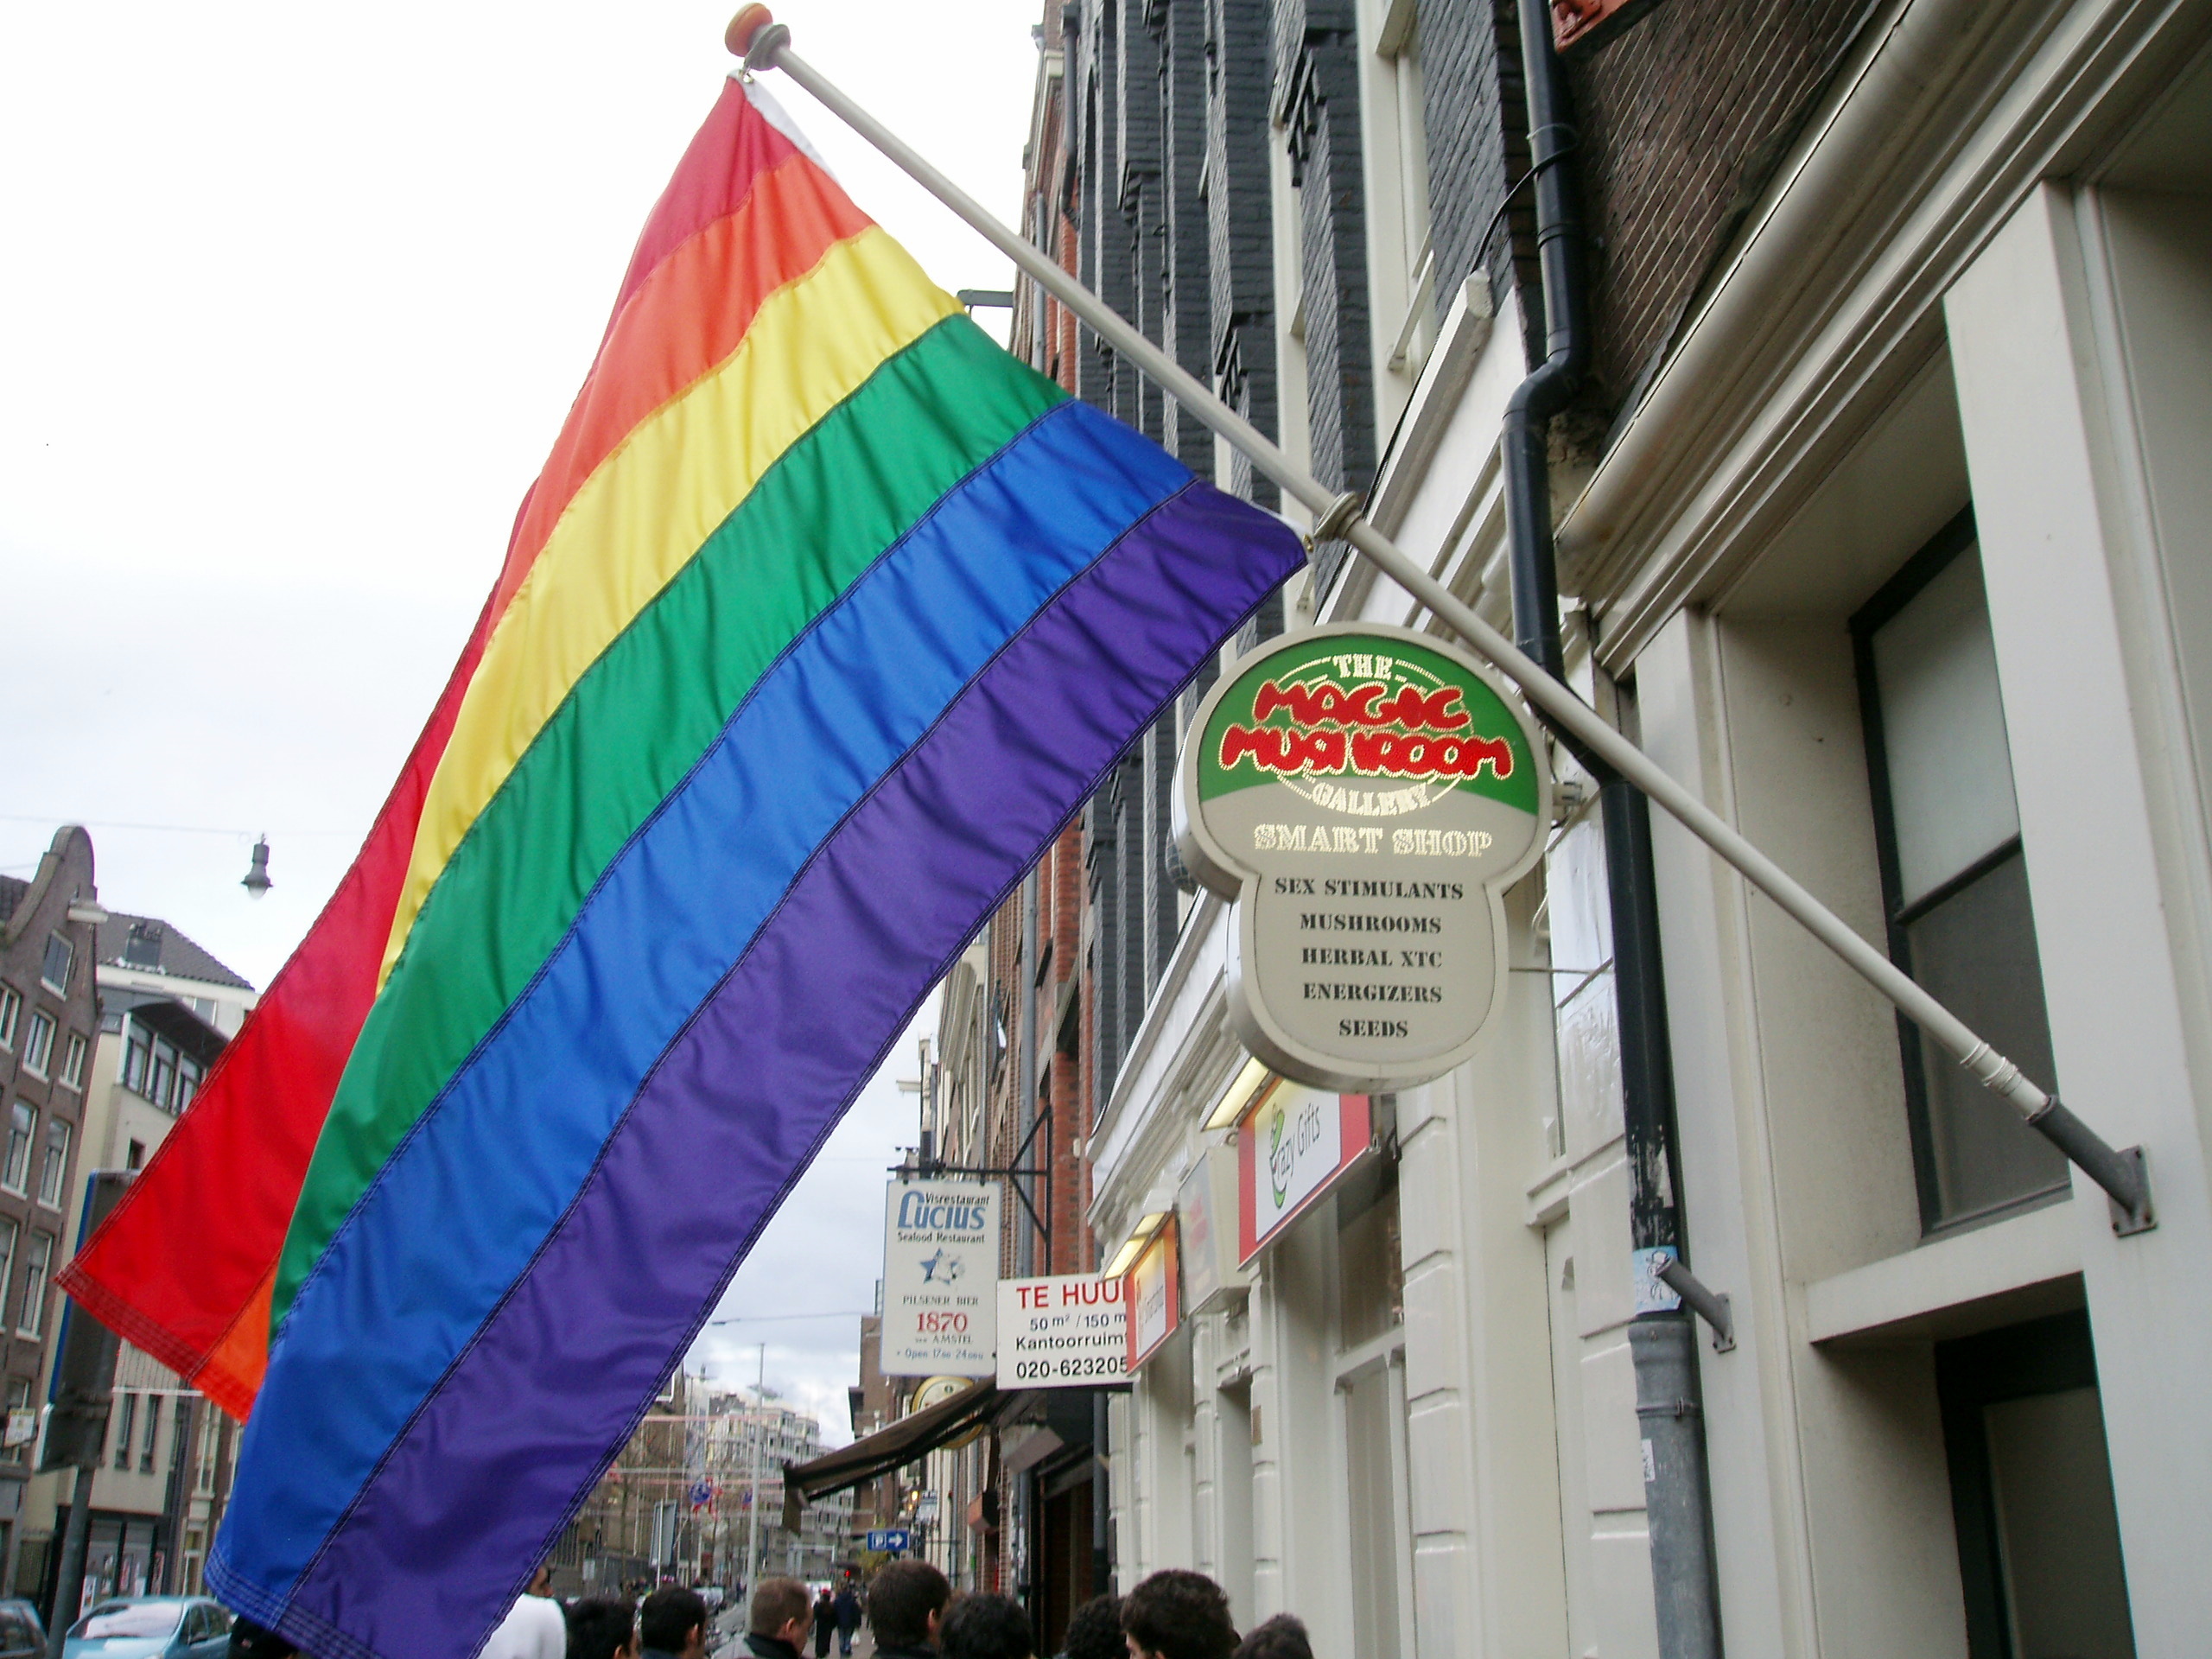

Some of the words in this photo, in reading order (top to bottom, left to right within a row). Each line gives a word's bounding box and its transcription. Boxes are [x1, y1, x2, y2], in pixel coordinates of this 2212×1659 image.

[1333, 654, 1393, 680] THE
[1313, 781, 1432, 816] GALLERY
[1254, 823, 1383, 855] SMART
[1392, 828, 1492, 857] SHOP
[1274, 877, 1315, 895] SEX
[1325, 879, 1464, 900] STIMULANTS
[1300, 912, 1442, 935] MUSHROOMS
[1301, 947, 1393, 967] HERBAL
[1401, 950, 1443, 969] XTC
[1303, 982, 1442, 1003] ENERGIZERS
[1338, 1019, 1408, 1038] SEEDS
[1298, 1103, 1320, 1157] Gifts
[898, 1190, 987, 1230] Lucius
[925, 1192, 990, 1206] Visrestaurant
[898, 1231, 932, 1243] Seafood
[936, 1231, 985, 1243] Restaurant
[1016, 1286, 1049, 1309] TE
[1062, 1280, 1125, 1306] HUU
[917, 1312, 968, 1332] 1870
[1030, 1316, 1048, 1332] 50
[1085, 1313, 1109, 1328] 150
[1016, 1332, 1127, 1351] Kantoorruim
[905, 1348, 928, 1360] Open
